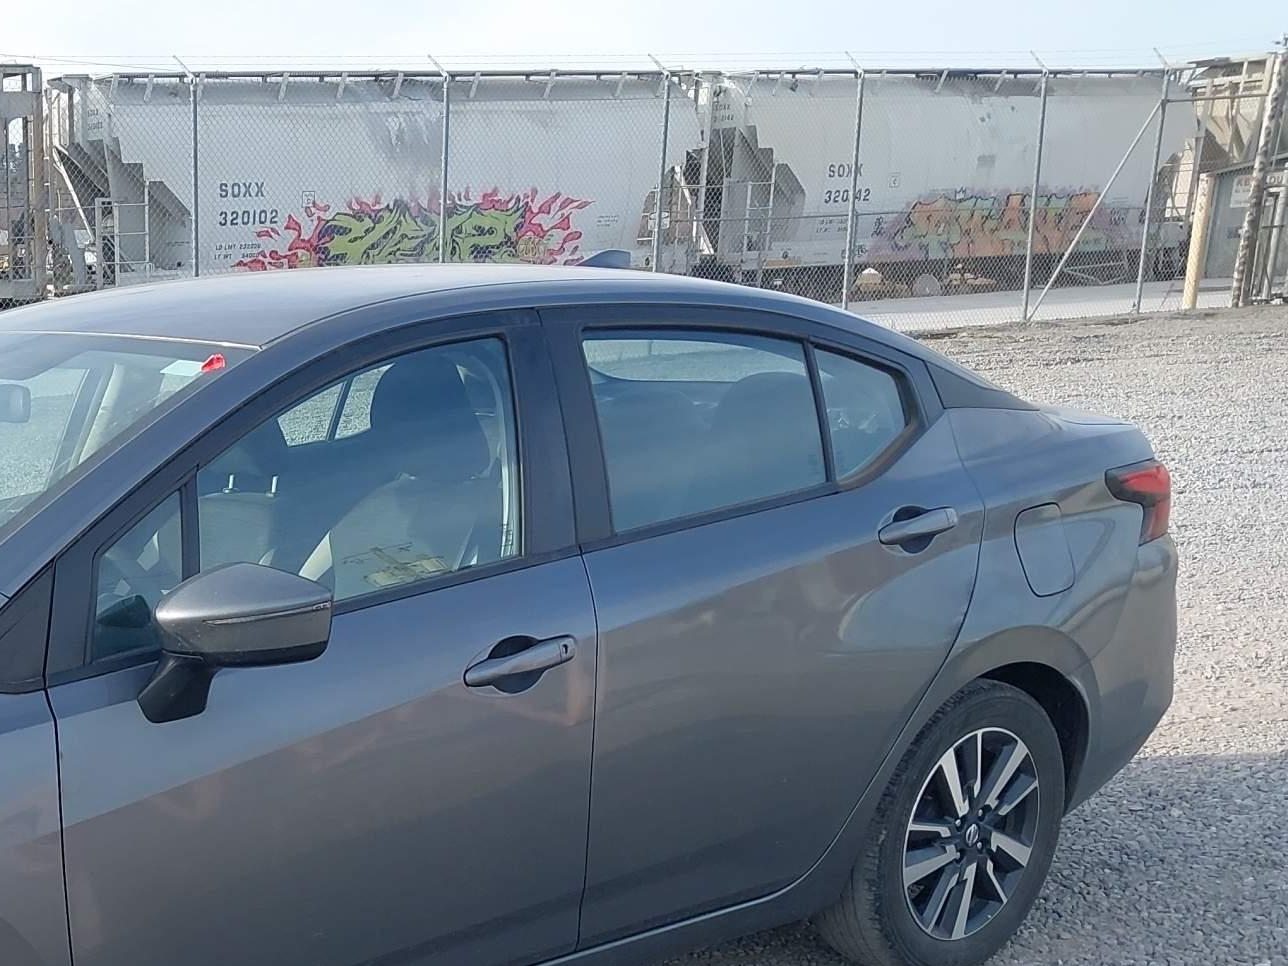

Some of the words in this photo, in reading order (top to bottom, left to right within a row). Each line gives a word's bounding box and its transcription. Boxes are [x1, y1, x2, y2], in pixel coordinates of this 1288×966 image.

[219, 182, 265, 198] SOXX
[824, 188, 871, 204] 32042
[219, 209, 278, 227] 320102
